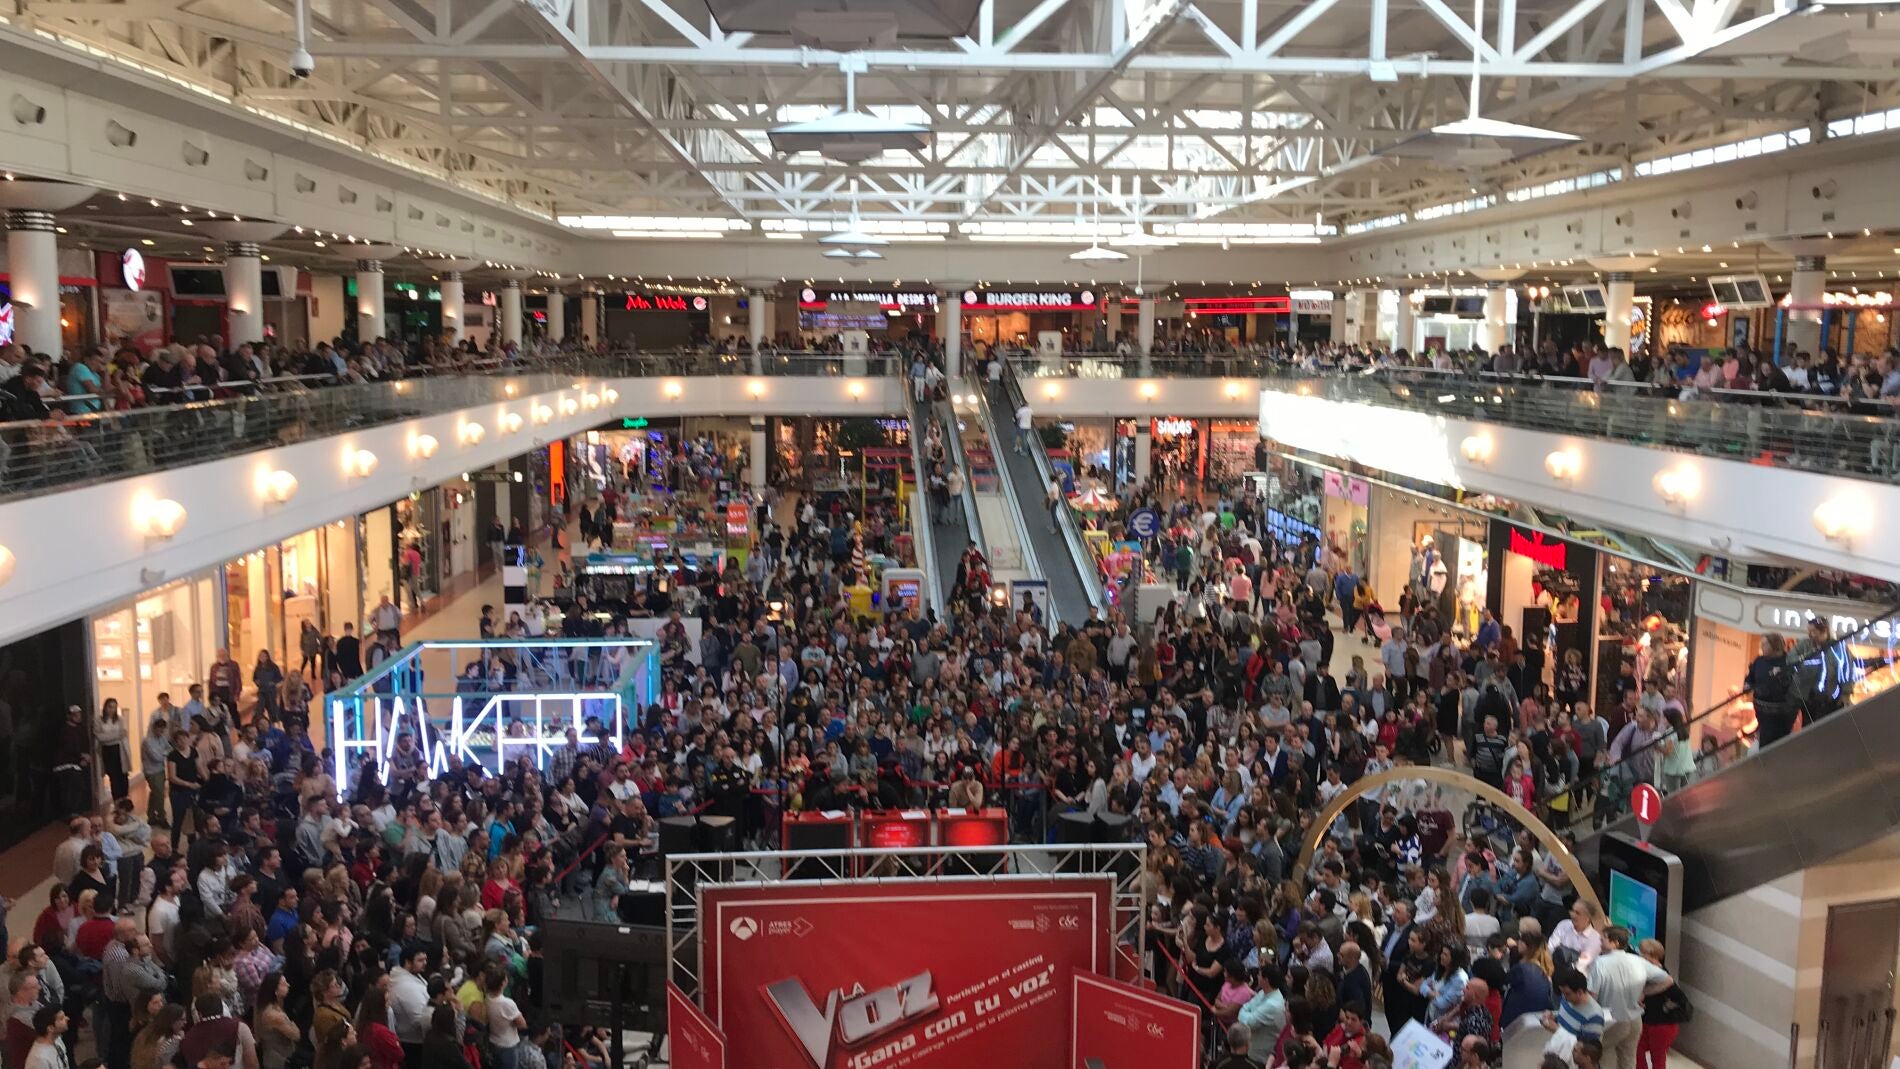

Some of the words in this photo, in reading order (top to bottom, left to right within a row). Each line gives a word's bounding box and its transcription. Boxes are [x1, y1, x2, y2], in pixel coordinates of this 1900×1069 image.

[897, 293, 925, 305] DESDE
[986, 292, 1038, 305] BURGER
[1039, 292, 1072, 305] KING
[947, 981, 986, 1005] Participa
[987, 975, 1000, 986] en
[1001, 968, 1011, 979] el
[1012, 954, 1044, 974] casting
[840, 981, 865, 1001] LA
[924, 1010, 967, 1040] con
[974, 993, 1001, 1016] tu
